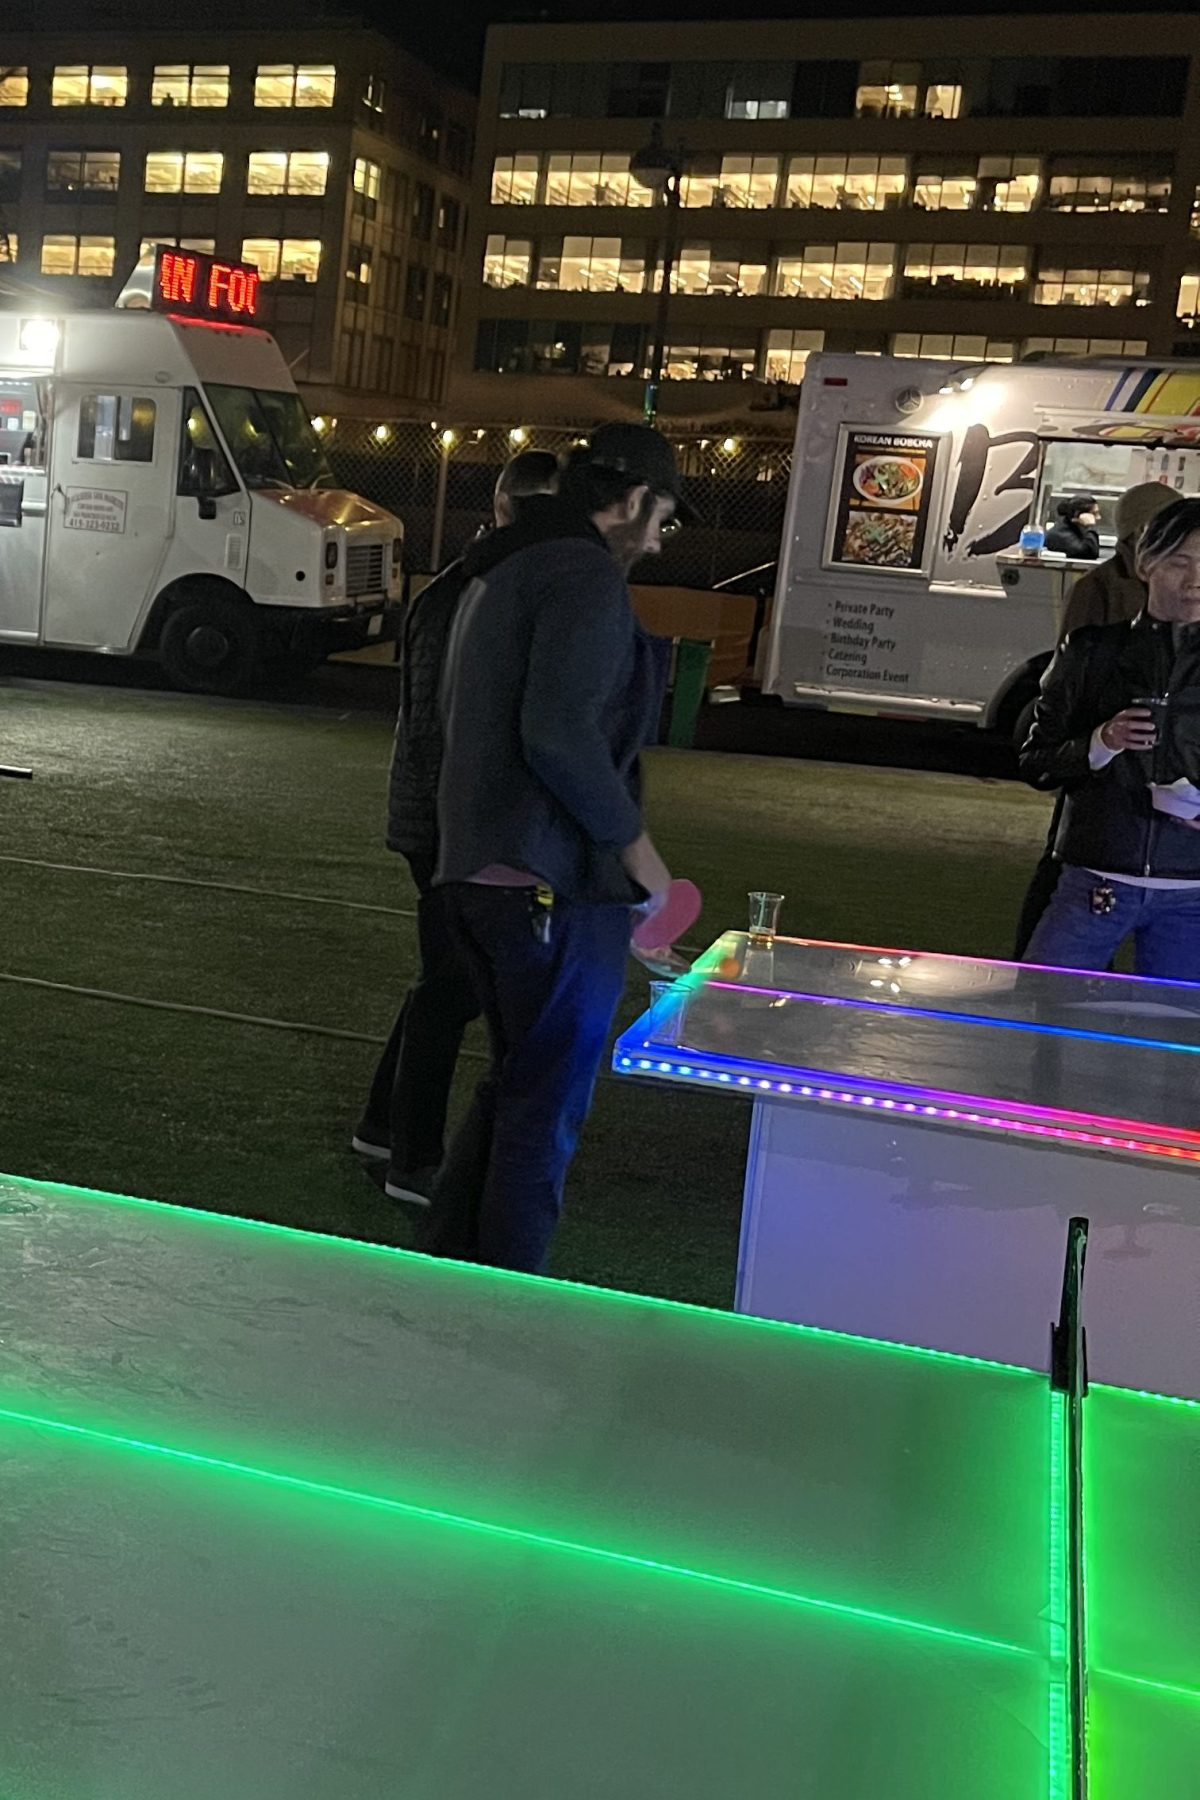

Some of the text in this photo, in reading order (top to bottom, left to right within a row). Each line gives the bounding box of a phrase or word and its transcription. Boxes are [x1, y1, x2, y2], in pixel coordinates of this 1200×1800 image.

[853, 434, 892, 446] KOREAN
[835, 600, 895, 619] Private Party
[833, 616, 874, 635] Wedding
[830, 632, 896, 653] Birthday Party
[828, 648, 867, 666] Catering
[826, 664, 909, 683] Corporation Event
